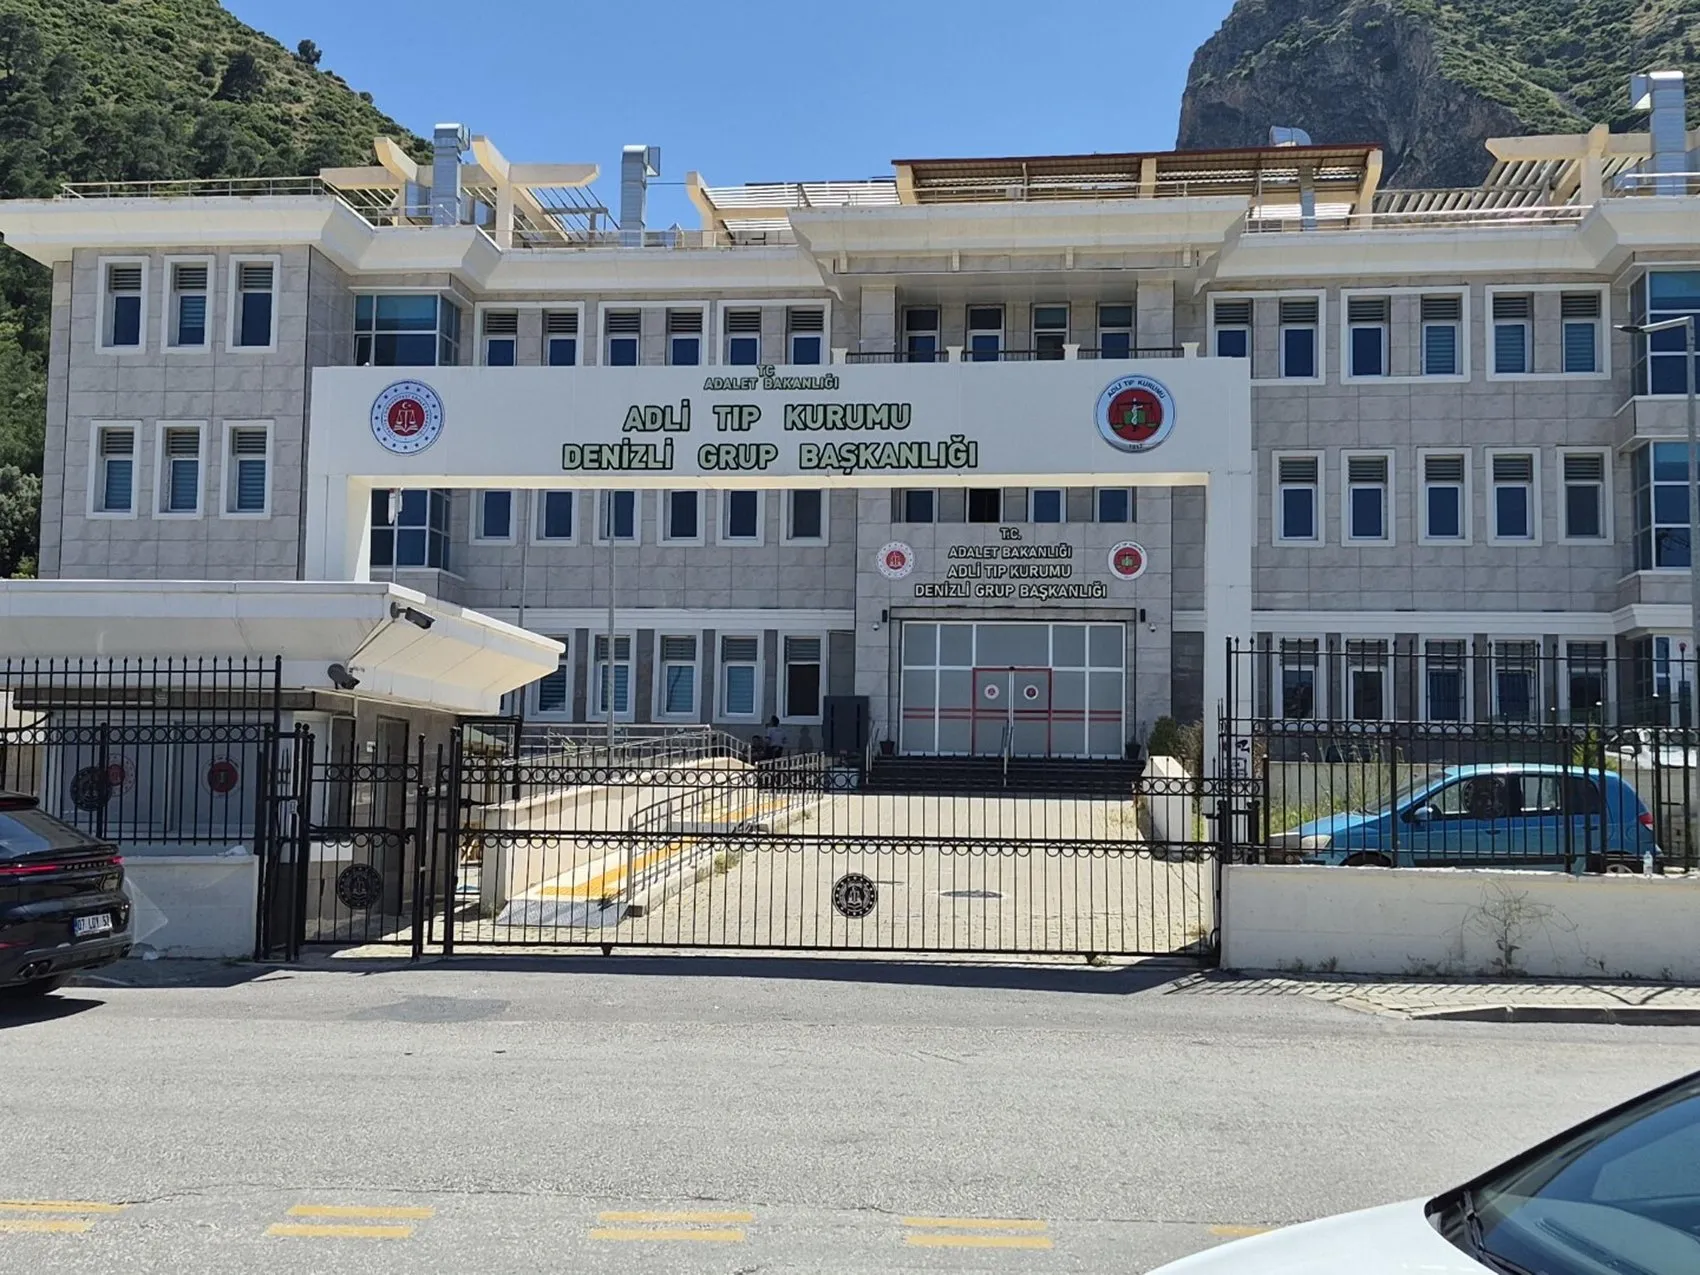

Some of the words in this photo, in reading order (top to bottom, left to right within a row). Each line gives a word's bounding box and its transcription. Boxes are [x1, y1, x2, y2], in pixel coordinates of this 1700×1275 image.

[703, 377, 759, 390] ADALET
[763, 373, 840, 390] BAKANLIĞI
[1137, 380, 1166, 399] KURUMU
[622, 398, 691, 432] ADLİ
[713, 404, 761, 432] TIP
[784, 403, 911, 431] KURUMU
[562, 437, 674, 470] DENİZLİ
[697, 443, 779, 470] GRUP
[800, 434, 978, 475] BAŞKANLIĞI
[1000, 527, 1022, 540] T.C.
[948, 546, 1000, 559] ADALET
[1001, 542, 1073, 559] BAKANLIĞI
[947, 562, 981, 578] ADLİ
[984, 565, 1008, 578] TIP
[1009, 564, 1073, 578] KURUMU
[915, 581, 971, 597] DENİZLİ
[975, 584, 1016, 598] GRUP
[1019, 581, 1107, 600] BAŞKANLIĞI
